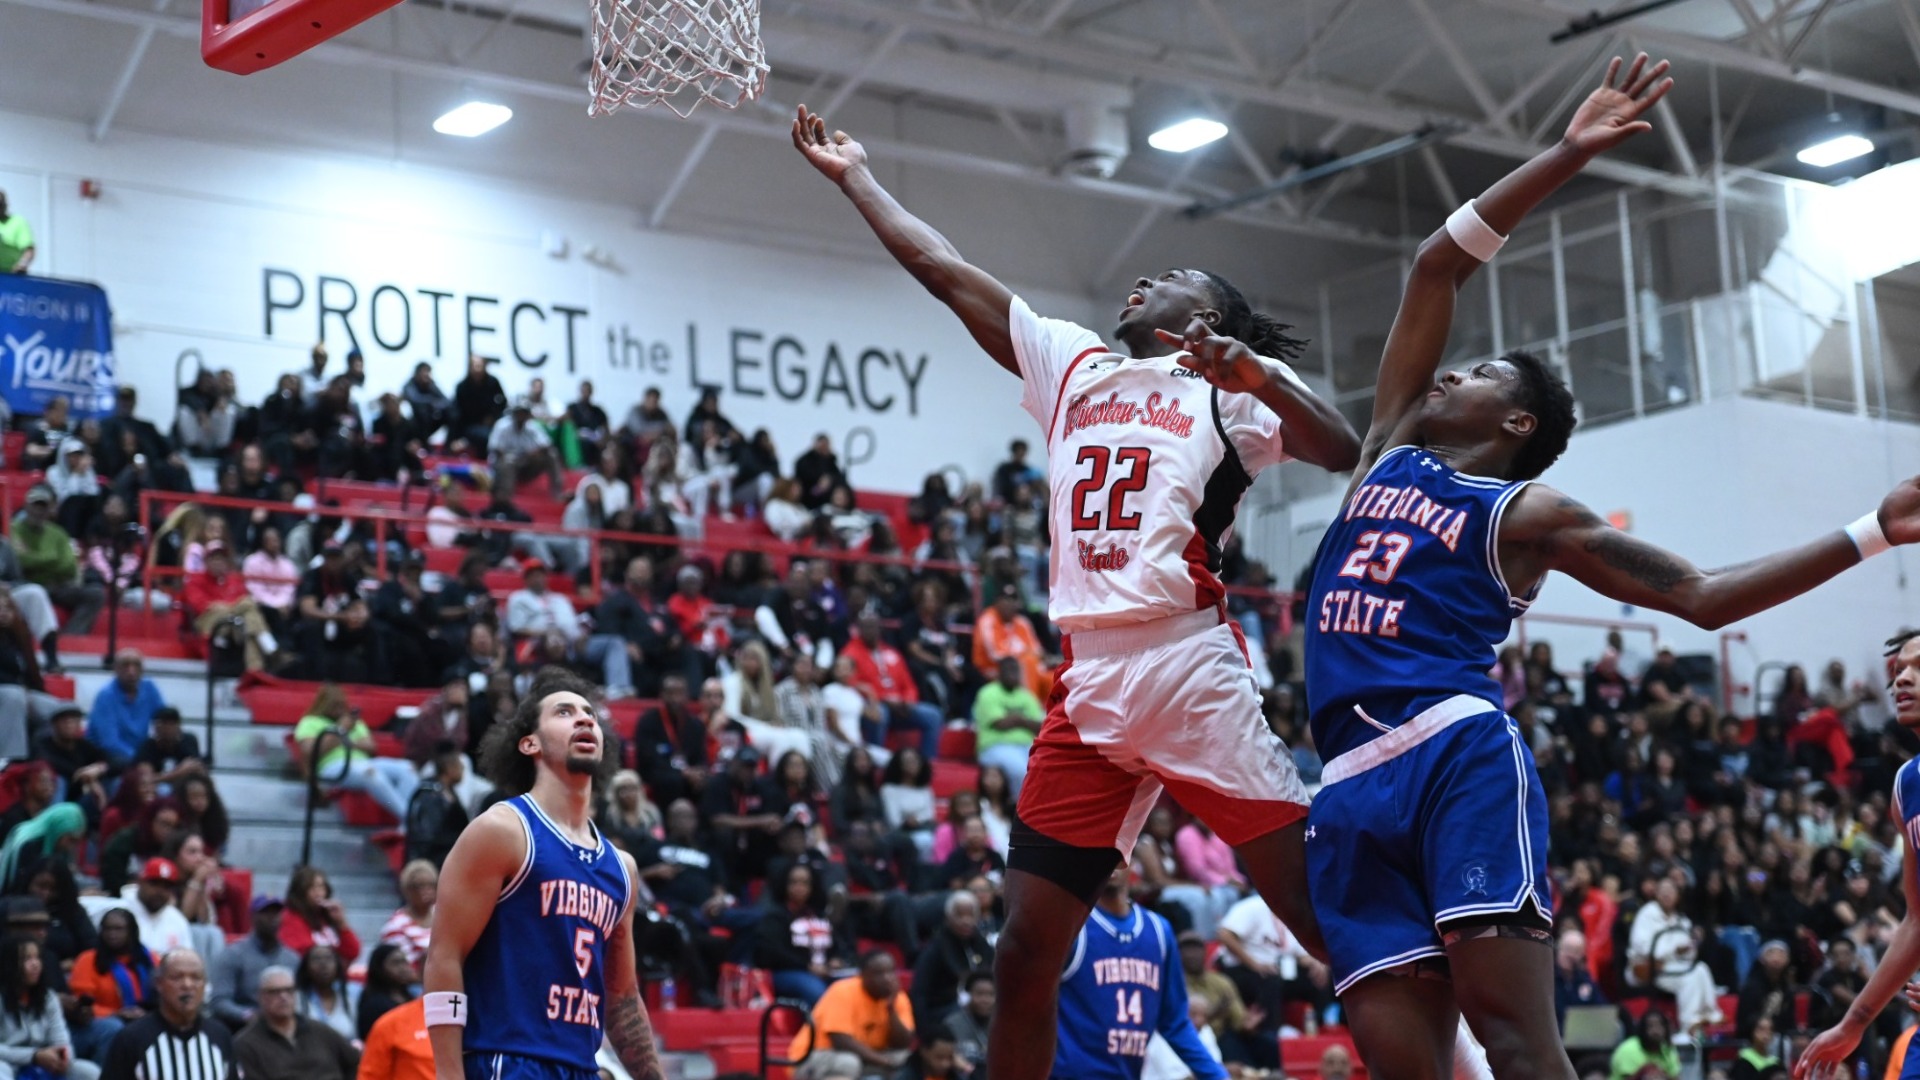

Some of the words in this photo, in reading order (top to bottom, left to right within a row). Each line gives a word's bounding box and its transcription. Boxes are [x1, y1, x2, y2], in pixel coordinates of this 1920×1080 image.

[263, 268, 588, 373] PROTECT
[607, 323, 672, 374] the
[686, 322, 928, 417] LEGACY
[1063, 391, 1195, 442] Winston-Salem
[1071, 445, 1151, 532] 22
[1344, 484, 1468, 553] VIRGINIA
[1077, 537, 1129, 573] State
[1337, 530, 1413, 585] 23
[1319, 589, 1406, 638] STATE
[574, 926, 595, 979] 5
[1093, 957, 1159, 991] VIRGINIA
[1116, 988, 1143, 1024] 14
[1107, 1028, 1148, 1057] STATE
